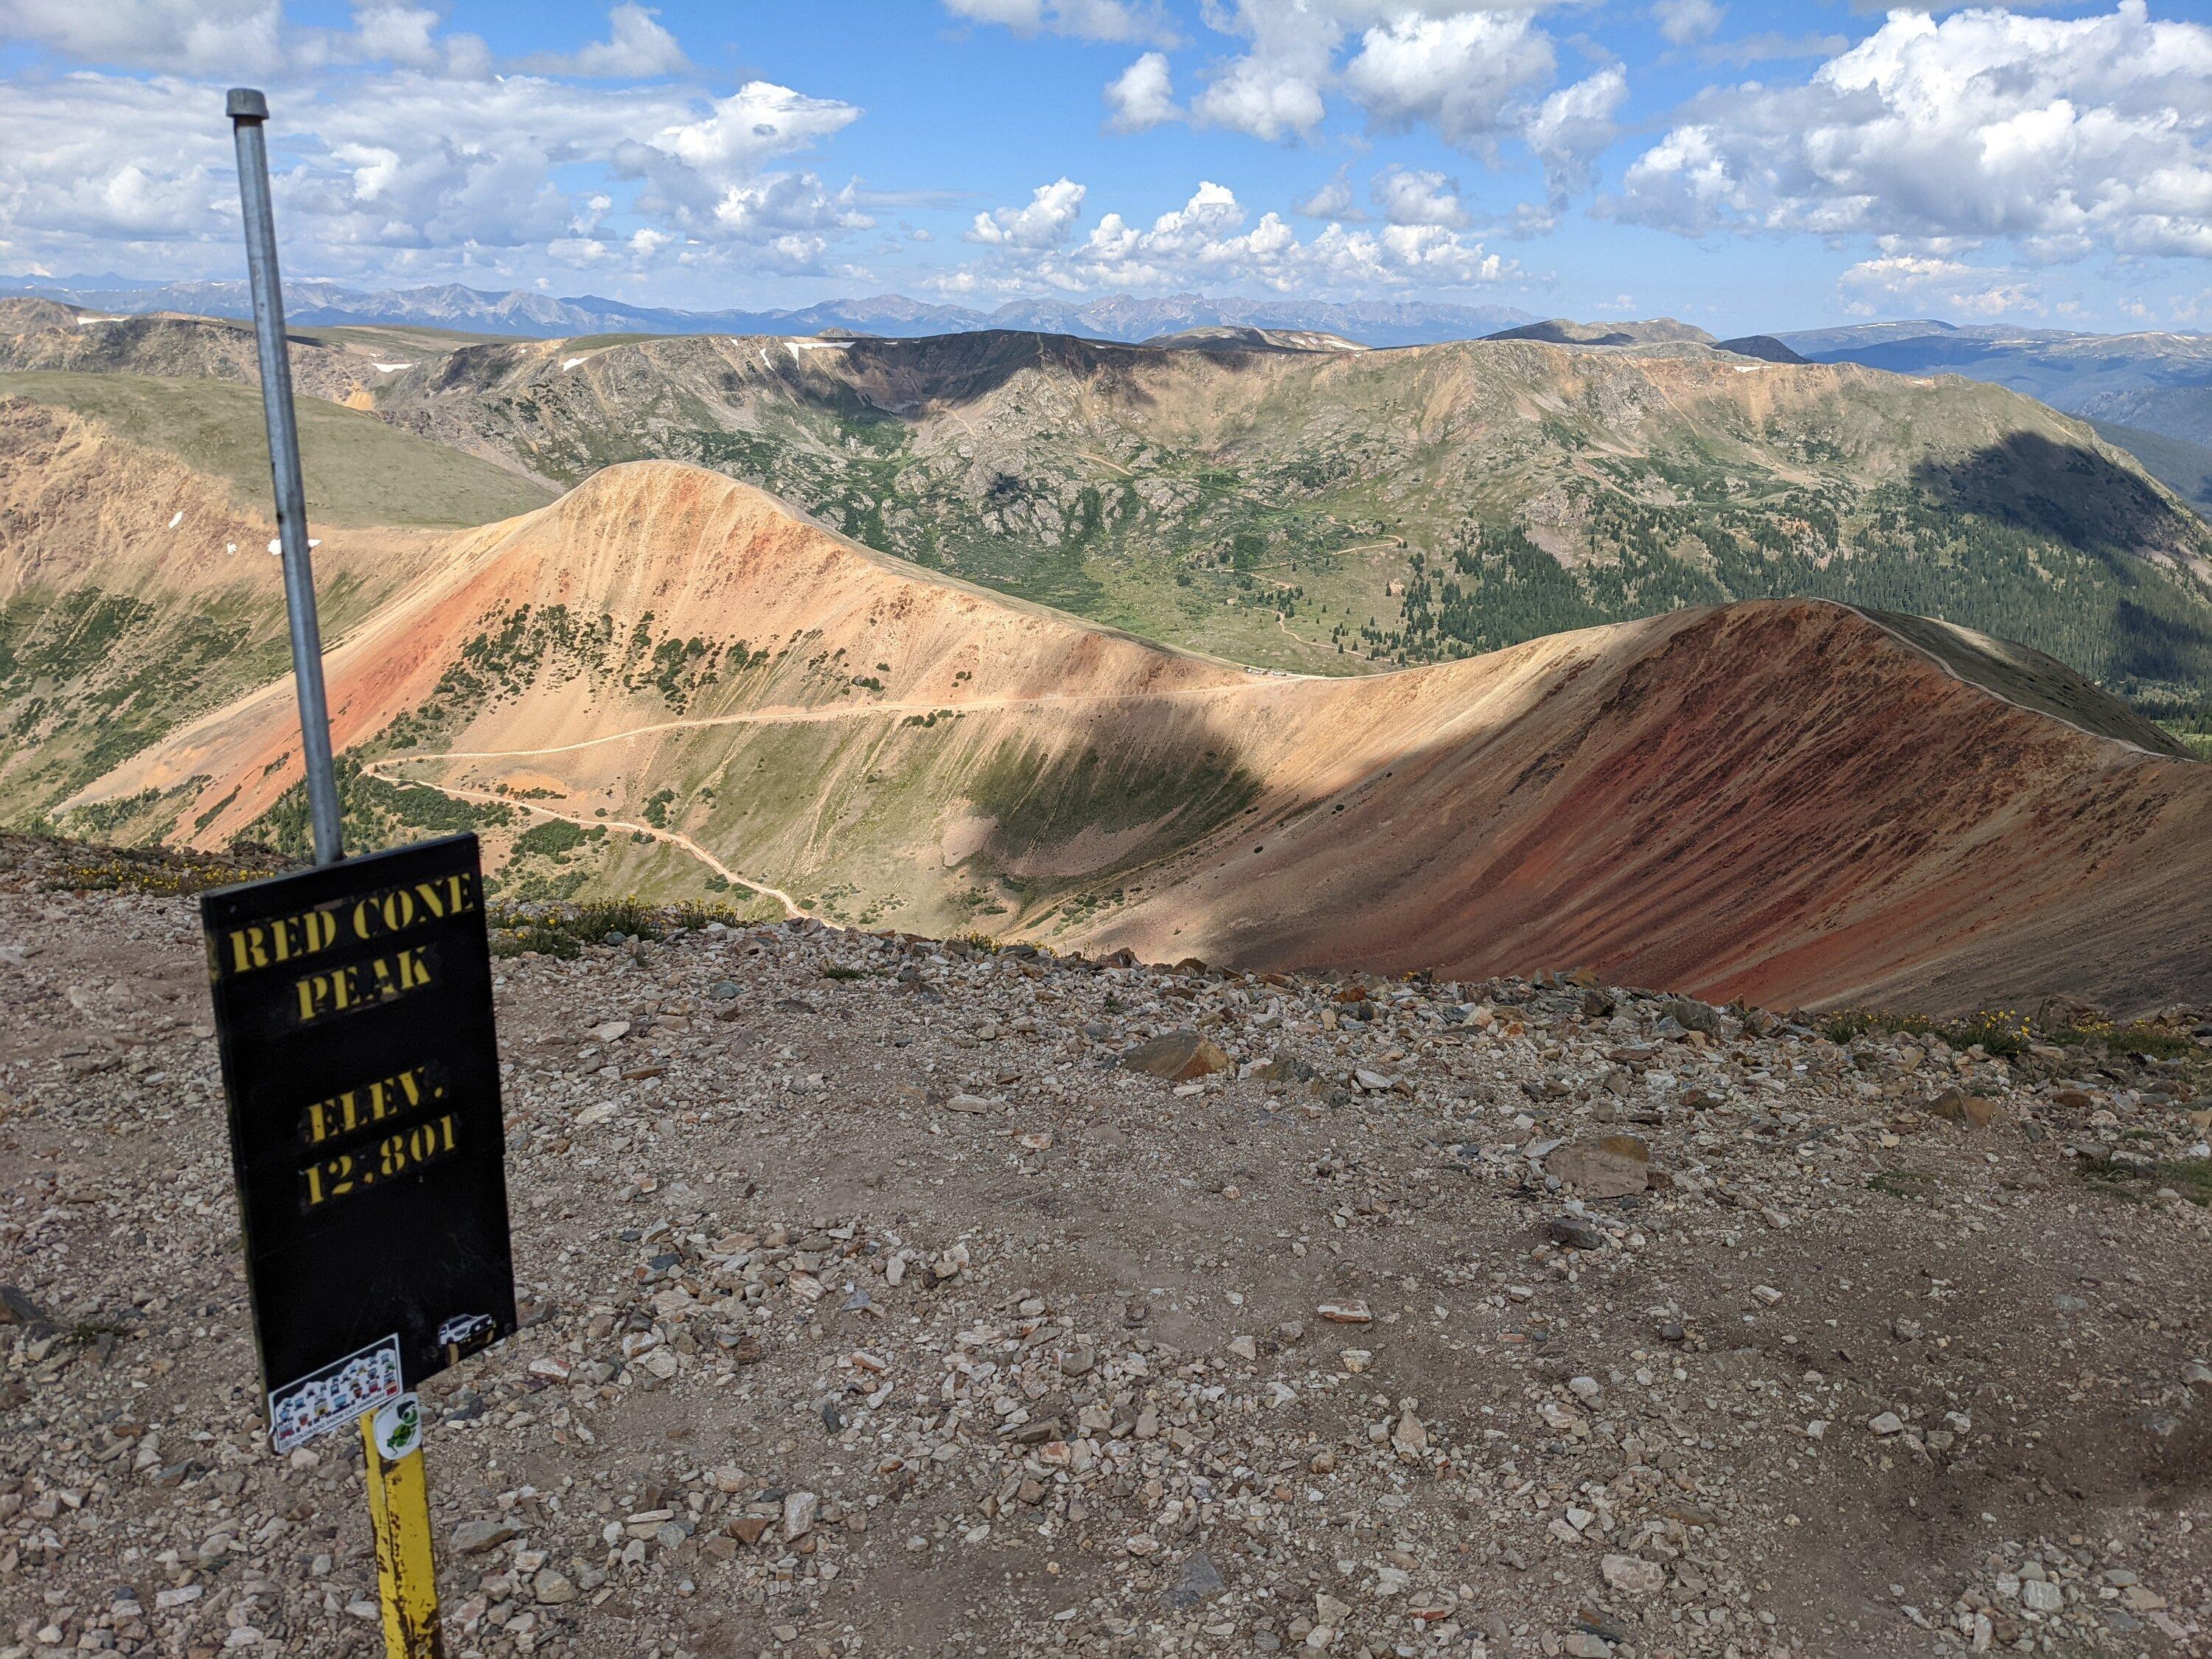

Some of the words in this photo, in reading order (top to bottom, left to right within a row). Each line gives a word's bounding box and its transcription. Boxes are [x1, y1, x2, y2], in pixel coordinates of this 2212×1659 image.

[229, 910, 336, 973] RED
[352, 872, 475, 940] CONE
[296, 945, 432, 1020] PEAK
[307, 1065, 443, 1143] ELEV.
